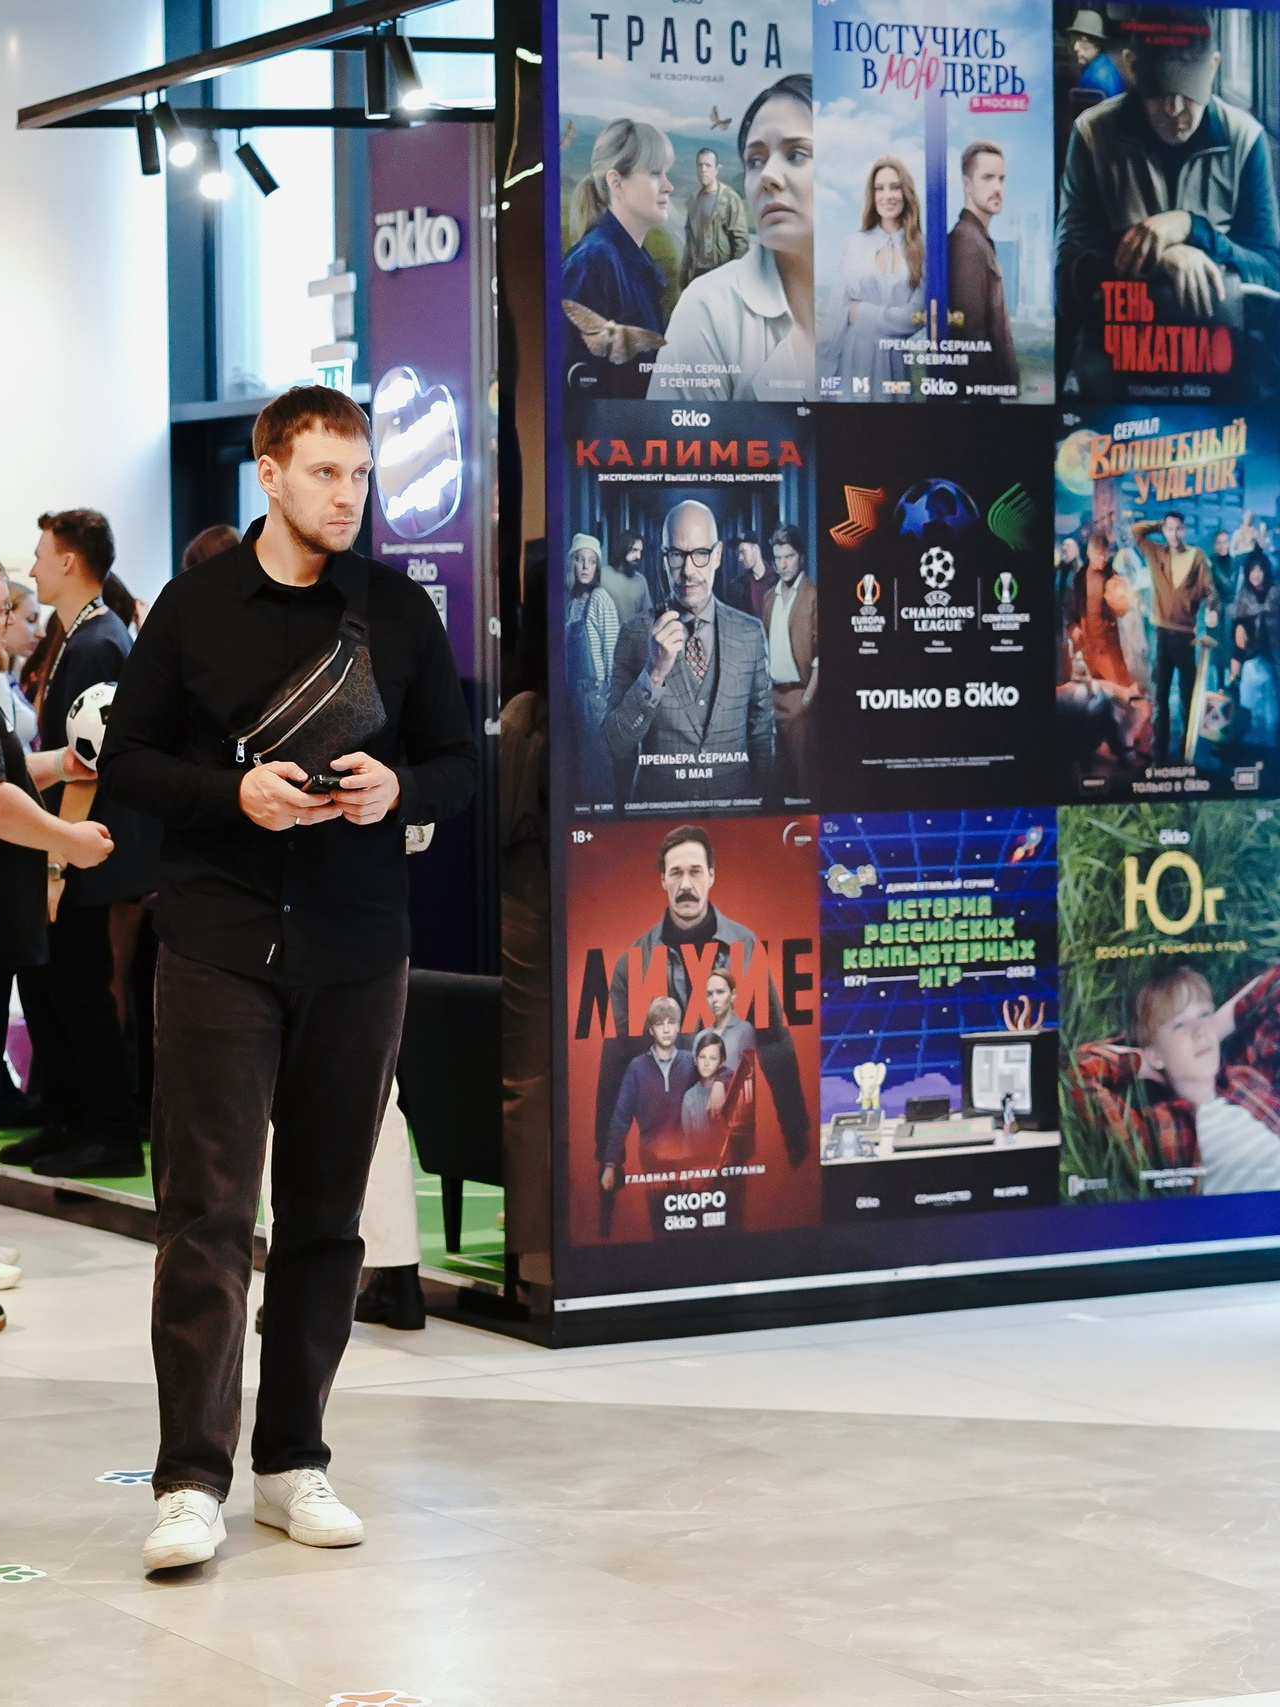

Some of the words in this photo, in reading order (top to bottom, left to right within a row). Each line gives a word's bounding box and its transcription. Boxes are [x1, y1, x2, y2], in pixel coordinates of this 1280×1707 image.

[590, 13, 782, 69] ТРАССА
[833, 20, 1006, 59] ПОСТУЧИСЬ
[862, 58, 878, 89] В
[880, 48, 940, 100] МОЮ
[940, 62, 1026, 98] ДВЕРЬ
[1101, 281, 1154, 322] ТЕНЬ
[879, 339, 938, 352] ПРЕМЬЕРА
[939, 340, 992, 352] СЕРИАЛА
[1104, 324, 1233, 374] ЧИКАТИЛО
[639, 362, 693, 374] ПРЕМЬЕРА
[695, 363, 741, 375] СЕРИАЛА
[902, 354, 914, 365] 12
[916, 354, 968, 366] ФЕВРАЛЯ
[660, 378, 667, 388] 5
[669, 378, 721, 389] СЕНТЯБРЯ
[973, 384, 1018, 396] PREMIER
[1114, 416, 1160, 441] СЕРИАЛ
[576, 439, 803, 467] КАЛИМБА
[598, 473, 663, 482] ЭКСПЕРИМЕНТ
[664, 473, 698, 482] ВЫШЕЛ
[735, 473, 783, 482] КОНТРОЛЯ
[1135, 458, 1237, 504] УЧАСТОК
[851, 616, 886, 626] EUROPA
[900, 606, 975, 620] CHAMPIONS
[854, 624, 883, 633] LEAGUE
[914, 619, 963, 632] LEAGUE
[856, 687, 942, 710] ТОЛЬКО
[945, 687, 961, 708] В
[638, 753, 696, 766] ПРЕМЬЕРА
[698, 752, 749, 764] СЕРИАЛА
[675, 769, 686, 779] 16
[688, 768, 713, 779] МАЯ
[571, 830, 594, 843] 18+
[1124, 850, 1225, 935] Юг
[887, 895, 992, 920] ИСТОРИЯ
[864, 917, 1015, 945] РОССИЙСКИХ
[842, 939, 1035, 969] КОМПЬЮТЕРНЫХ
[844, 975, 867, 987] 1971
[918, 966, 962, 988] ИГР
[575, 938, 814, 1040] ЛИХИЕ
[625, 1171, 676, 1184] ГЛАВНАЯ
[679, 1168, 718, 1181] ДРАМА
[721, 1164, 766, 1177] СТРАНЫ
[664, 1190, 727, 1212] СКОРО
